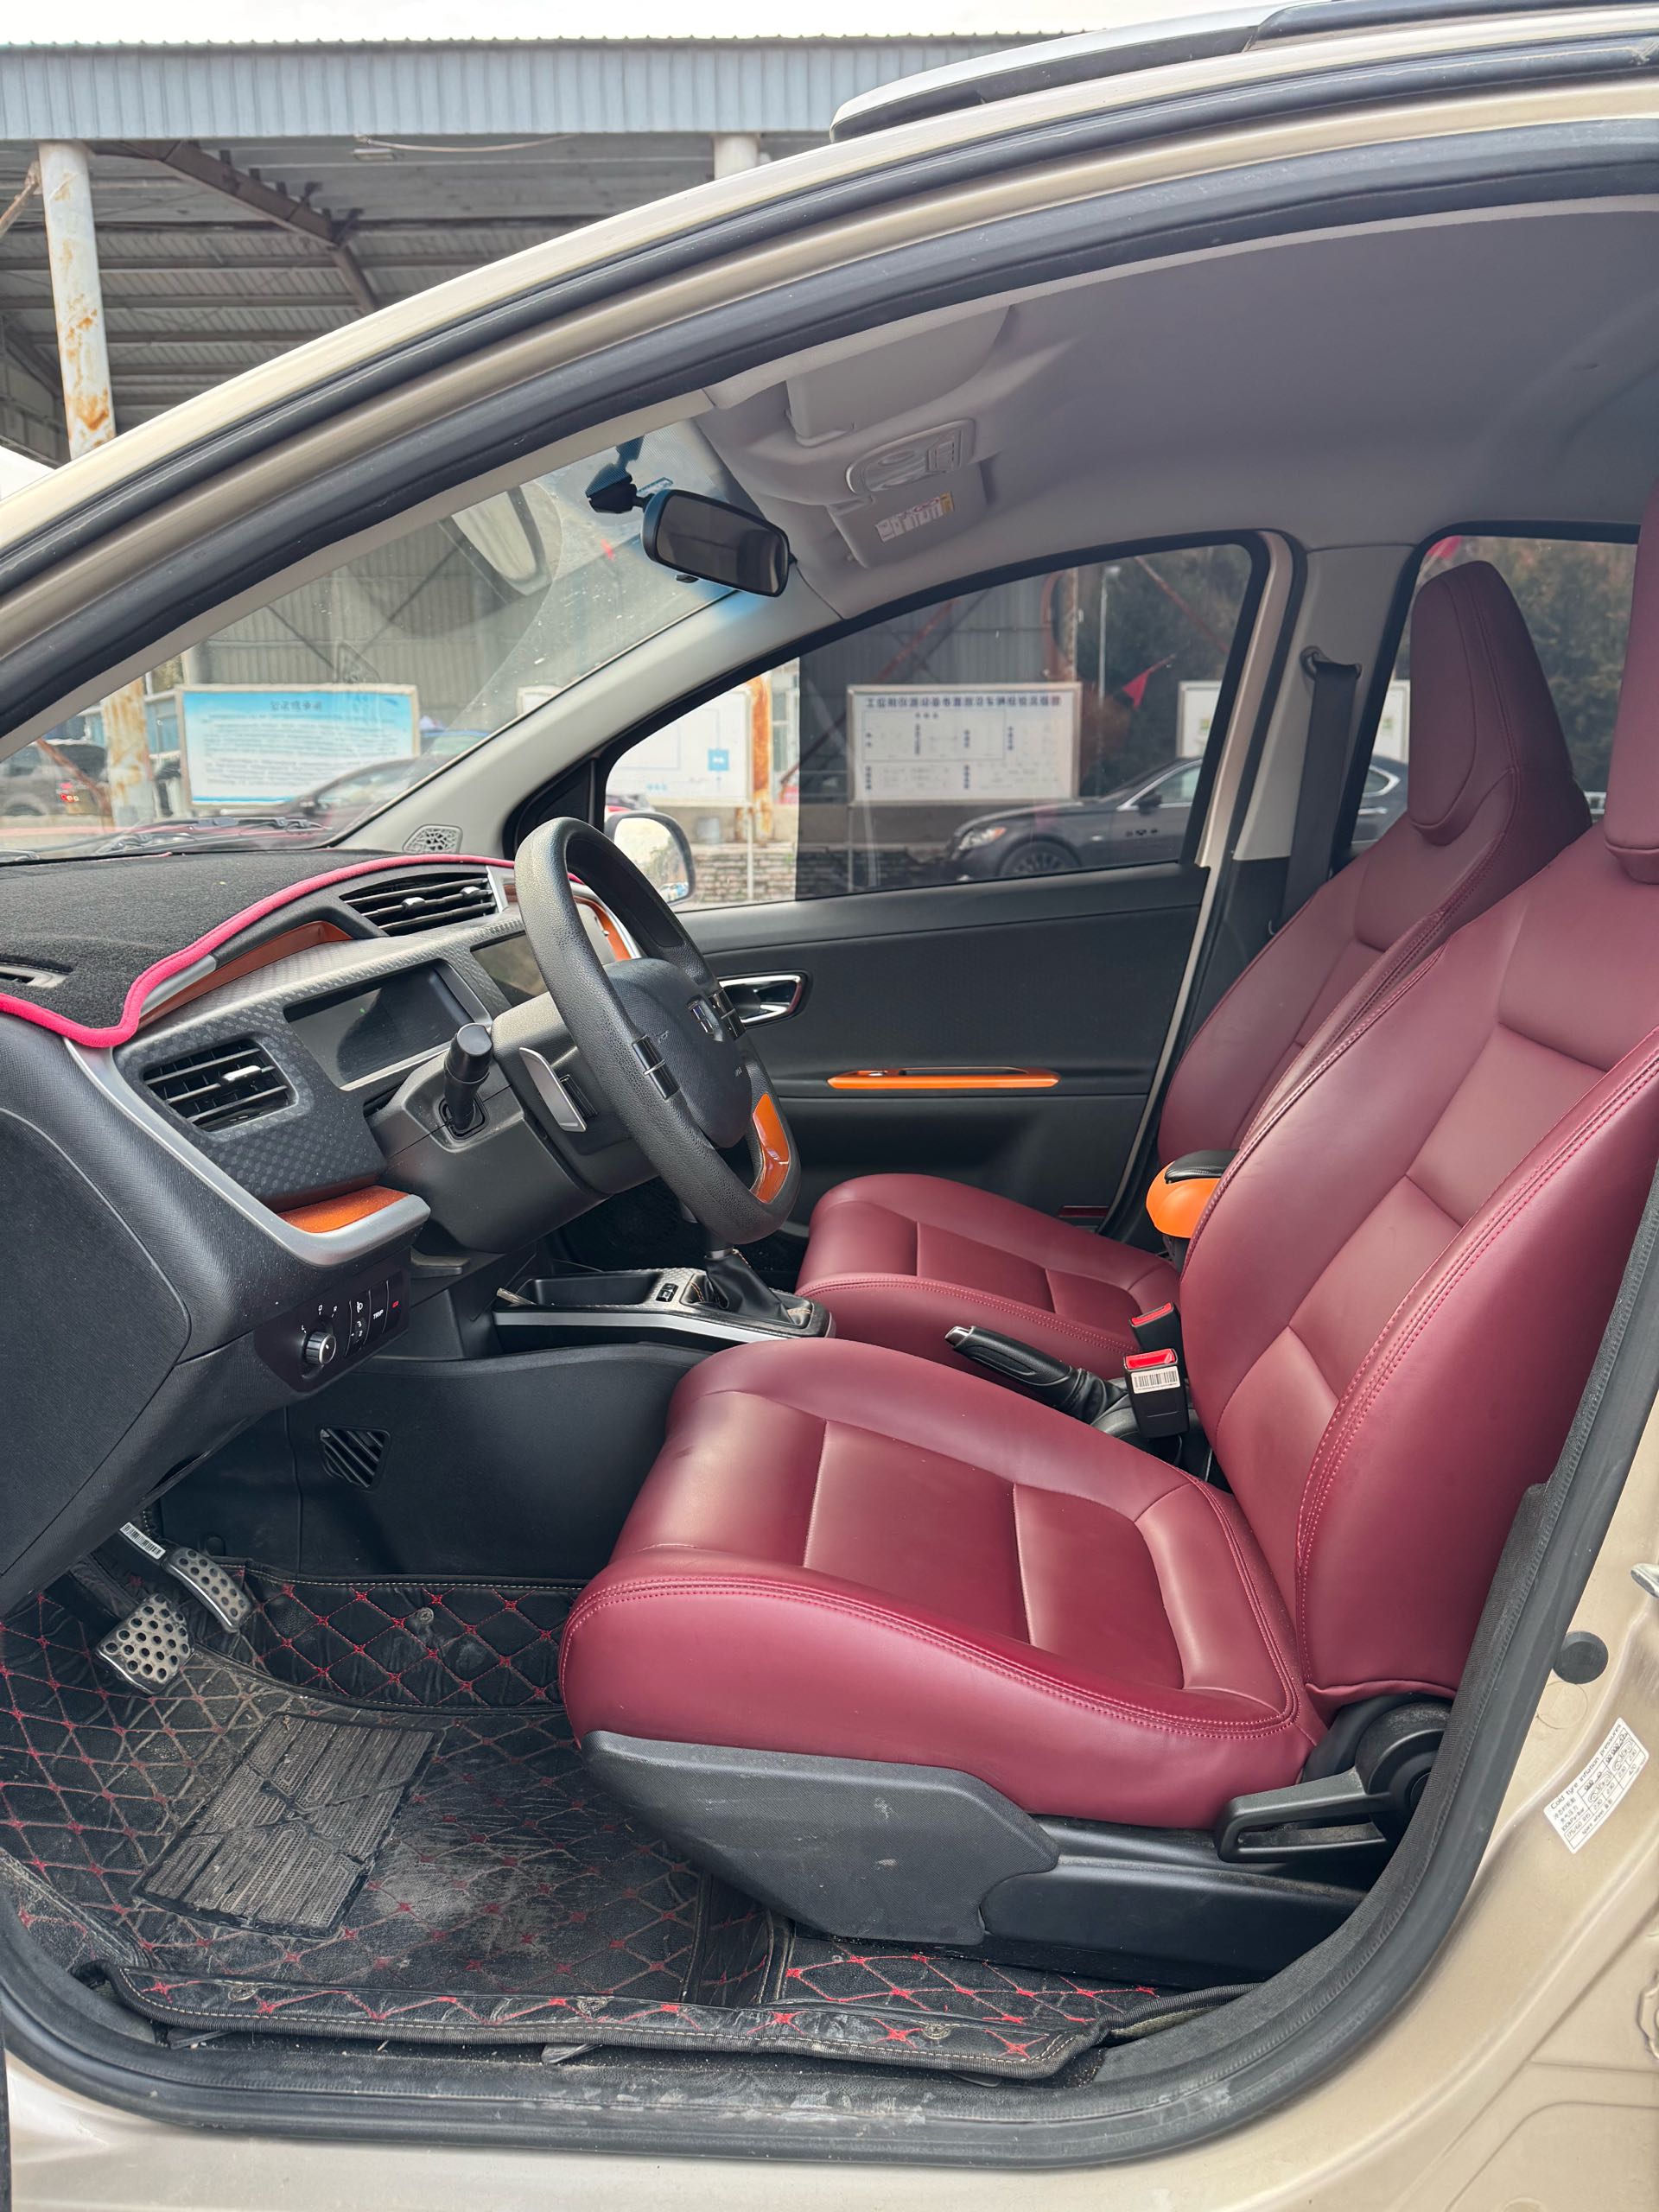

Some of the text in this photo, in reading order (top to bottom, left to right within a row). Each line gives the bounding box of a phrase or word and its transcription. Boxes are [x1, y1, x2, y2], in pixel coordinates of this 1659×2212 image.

[372, 1309, 384, 1319] TRIP
[1550, 1723, 1622, 1809] Cold tyre inflation pressures
